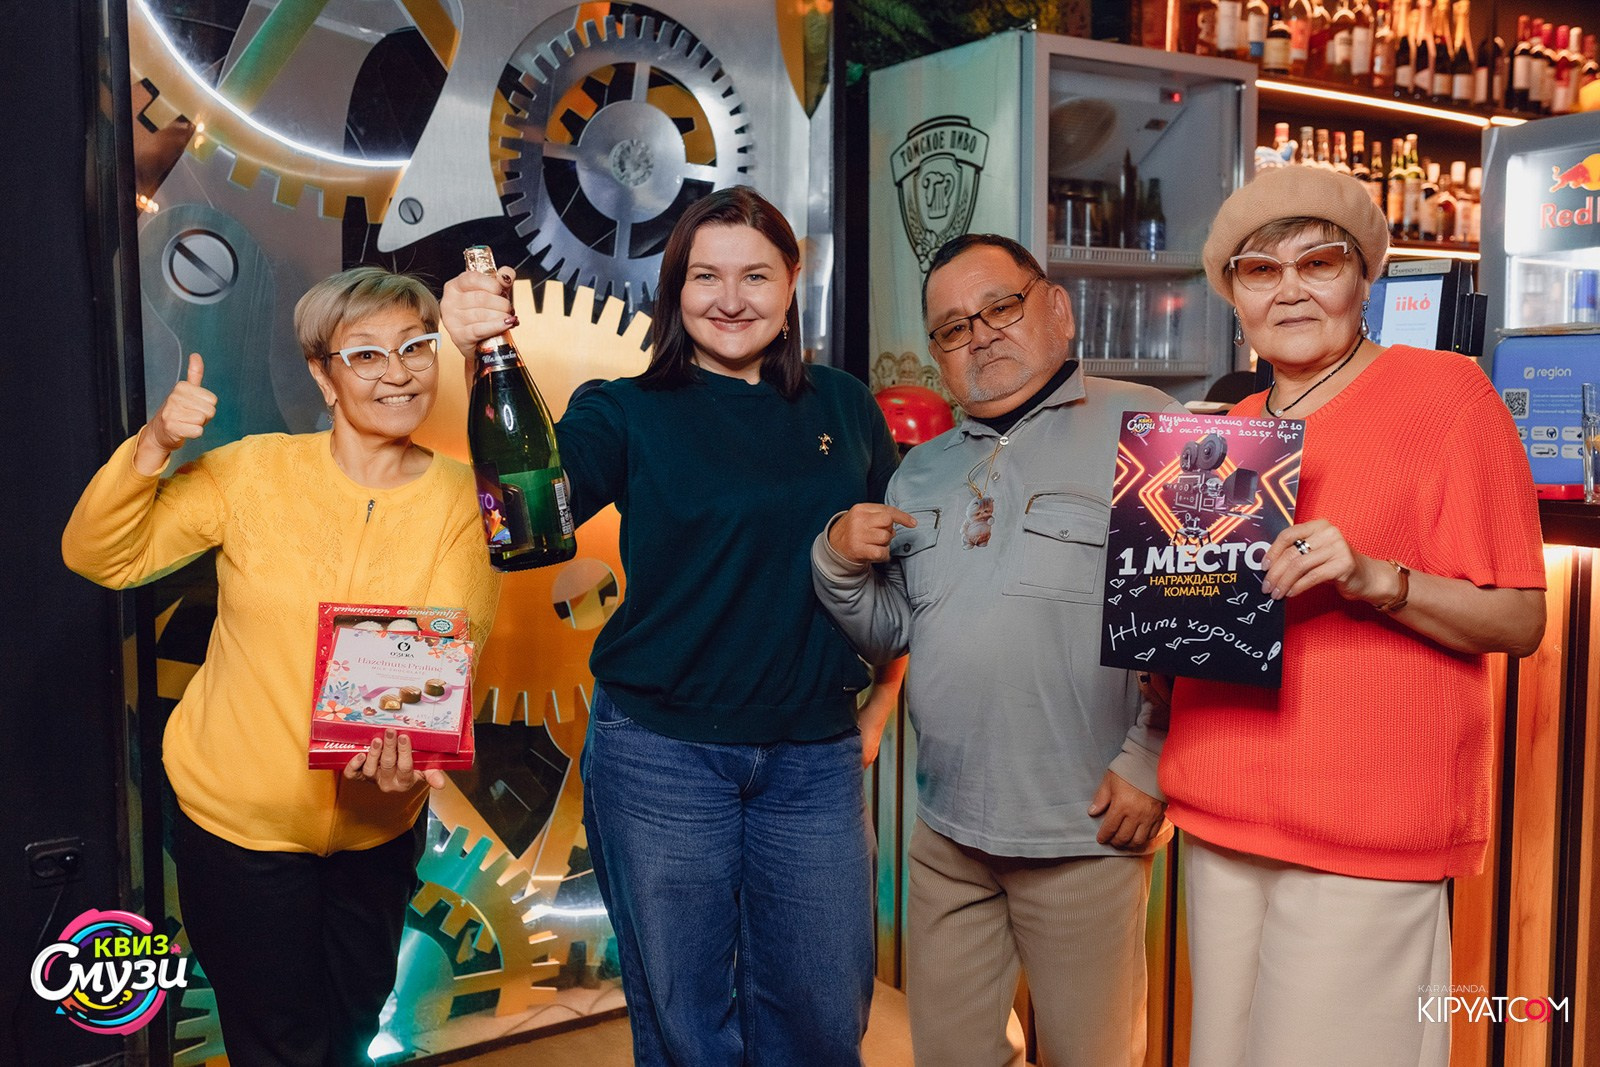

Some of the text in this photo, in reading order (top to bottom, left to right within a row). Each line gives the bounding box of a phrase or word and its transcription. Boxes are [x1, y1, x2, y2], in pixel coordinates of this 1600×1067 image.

[900, 130, 977, 167] ТОМСКОЕ ПИВО
[1540, 196, 1594, 229] Red
[1536, 365, 1572, 380] region
[1127, 420, 1156, 433] Смузи
[1118, 541, 1272, 576] 1 МЕСТО
[1149, 573, 1238, 586] НАГРАЖДАЕТСЯ
[1164, 585, 1221, 597] КОМАНДА
[1108, 612, 1178, 651] Жить
[357, 657, 443, 673] Hazelnuts Praline
